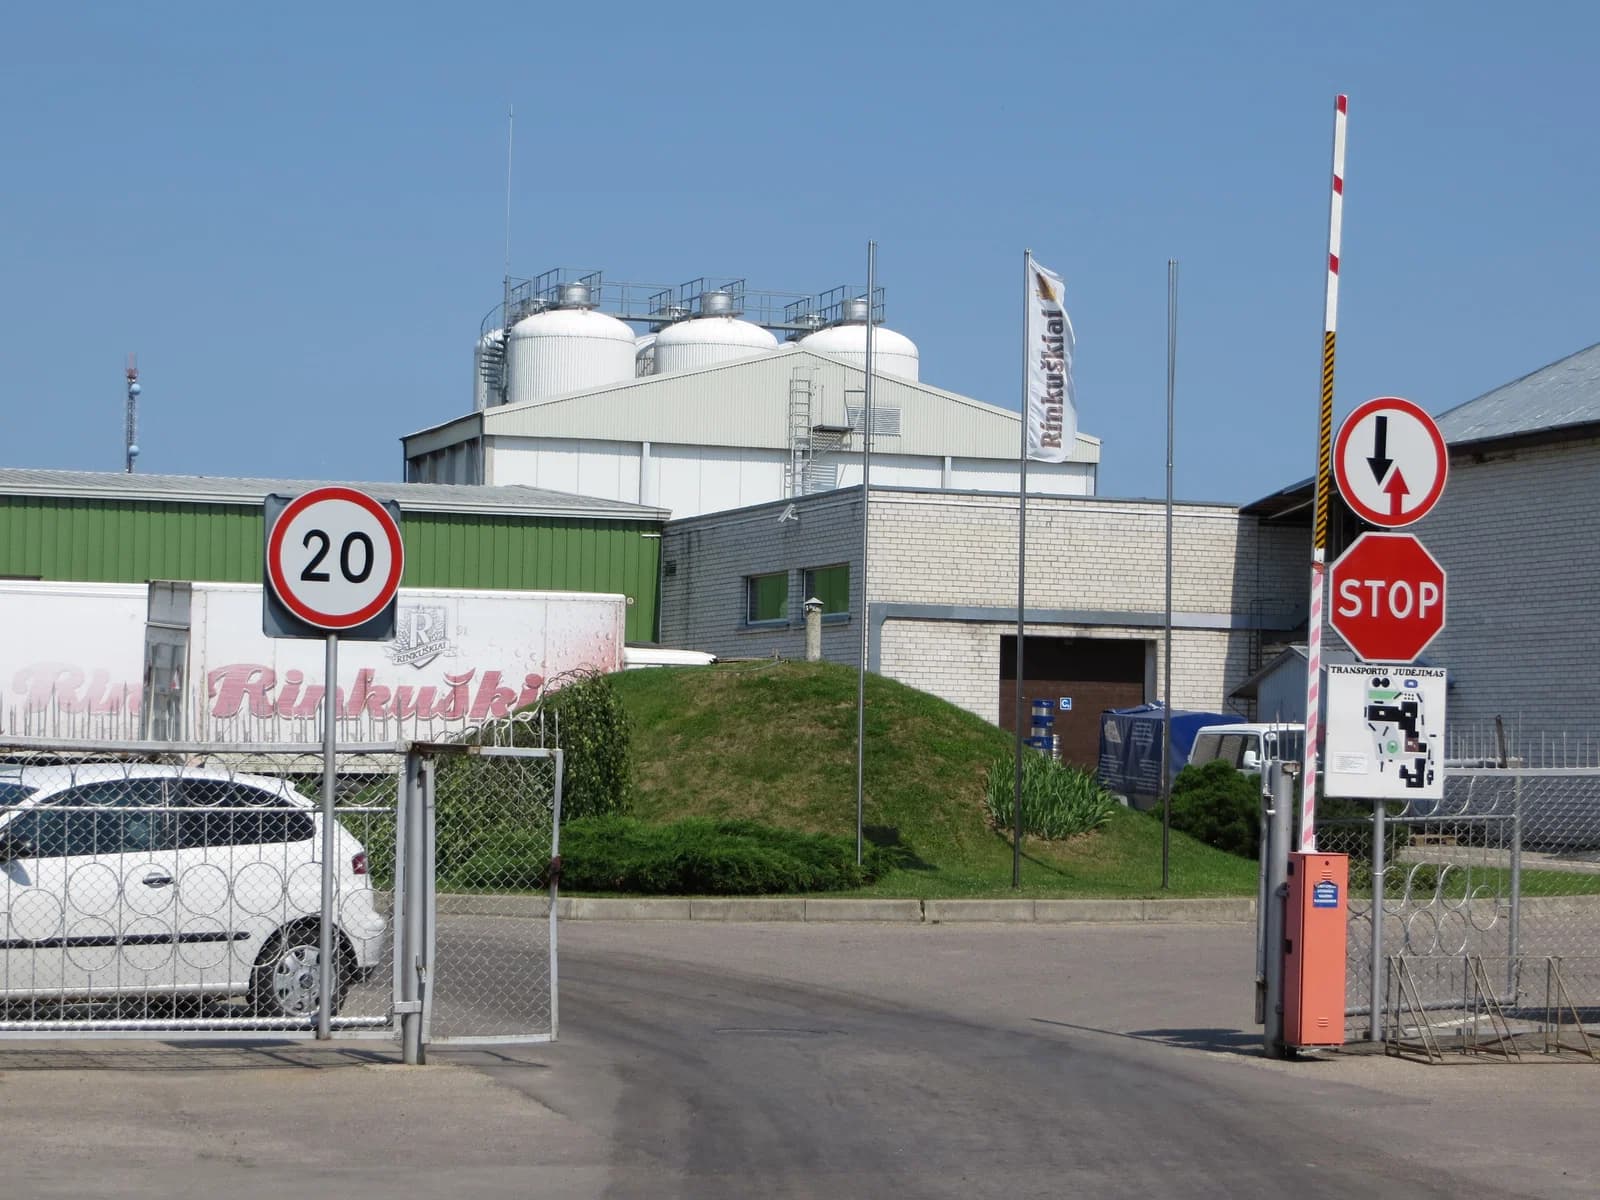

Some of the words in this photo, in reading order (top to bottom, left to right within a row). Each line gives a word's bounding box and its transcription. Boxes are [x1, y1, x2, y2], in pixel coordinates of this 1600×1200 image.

[1040, 309, 1065, 449] Rinkuškiai
[300, 529, 375, 584] 20
[1338, 579, 1439, 619] STOP
[207, 663, 561, 721] Rinkuški
[1330, 666, 1389, 675] TRANSPORTO
[1393, 668, 1445, 678] JUDĖJIMAS
